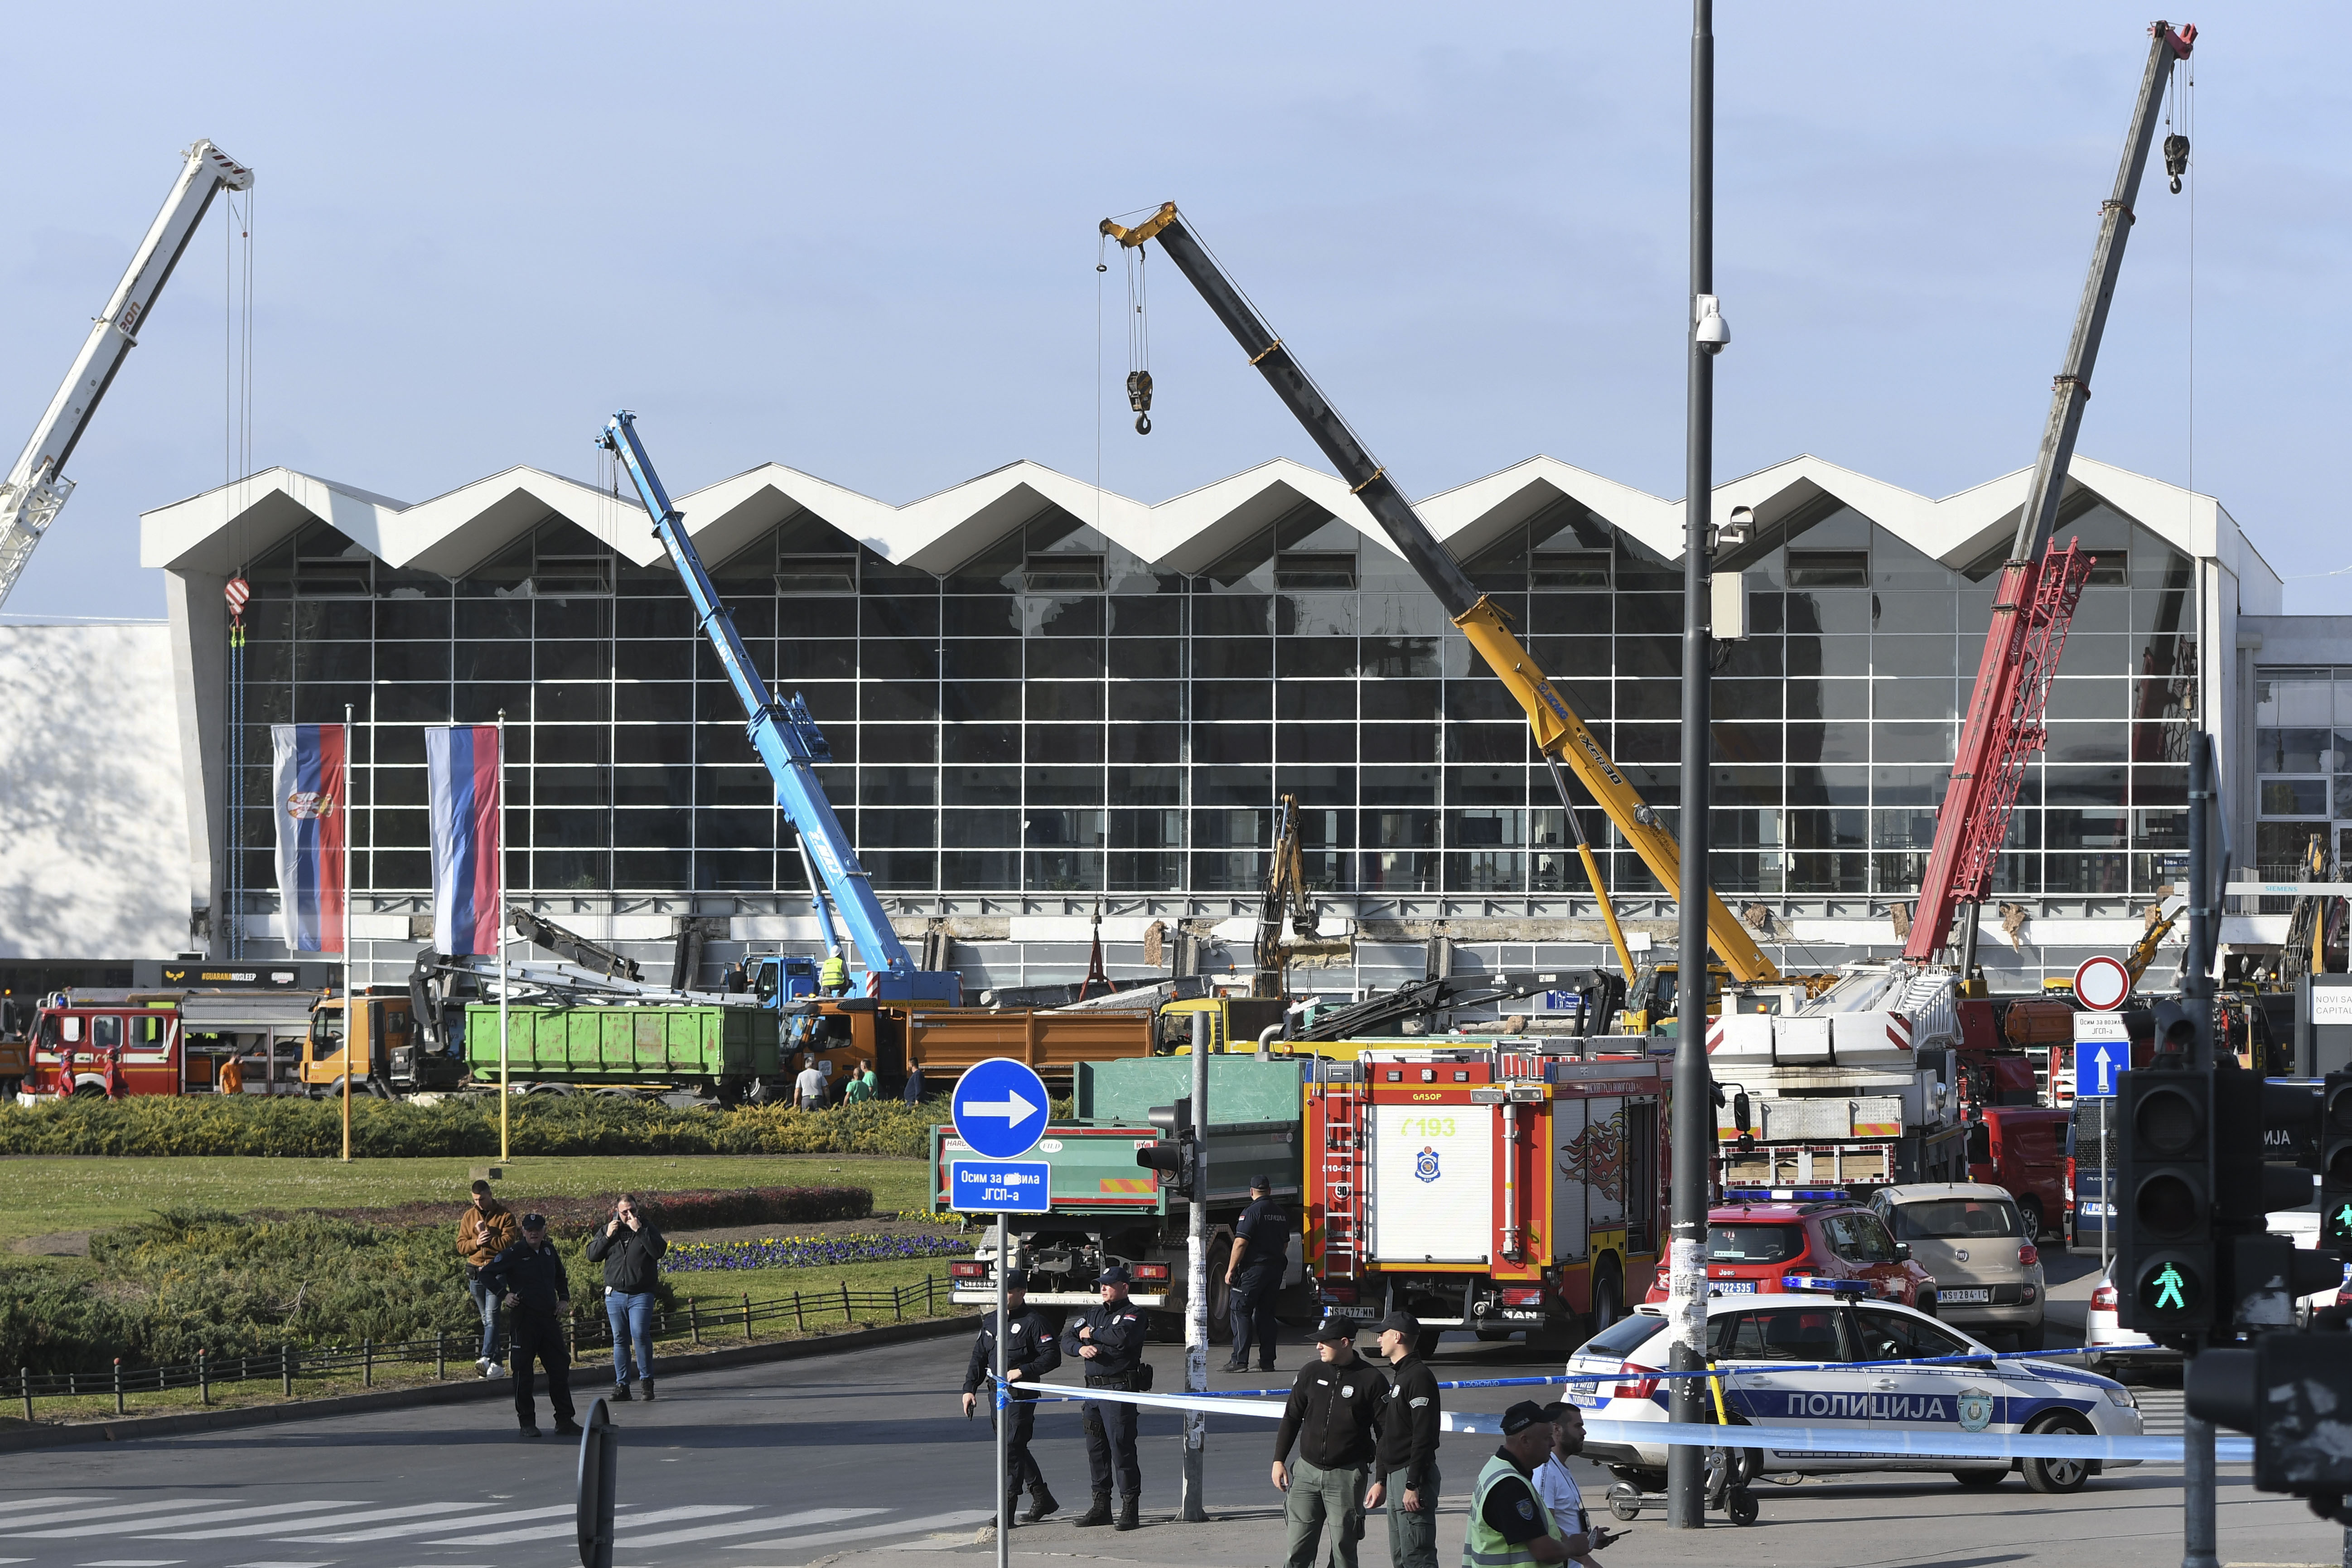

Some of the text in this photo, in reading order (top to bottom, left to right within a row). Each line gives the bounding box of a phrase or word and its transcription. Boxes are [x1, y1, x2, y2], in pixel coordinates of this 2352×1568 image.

[1545, 691, 1569, 719] XCMG
[1580, 737, 1623, 786] XCR30
[1416, 1117, 1456, 1137] 193
[961, 1170, 987, 1183] Осим
[990, 1174, 1001, 1183] за
[982, 1187, 1019, 1201] ЈГСП-а
[1337, 1186, 1347, 1196] 90
[1942, 1291, 1952, 1300] NS
[1329, 1307, 1339, 1316] NS
[1502, 1311, 1537, 1319] MAN
[1572, 1395, 1597, 1407] ПОЛИЦИЈА
[1787, 1393, 1946, 1419] ПОЛИЦИЈА
